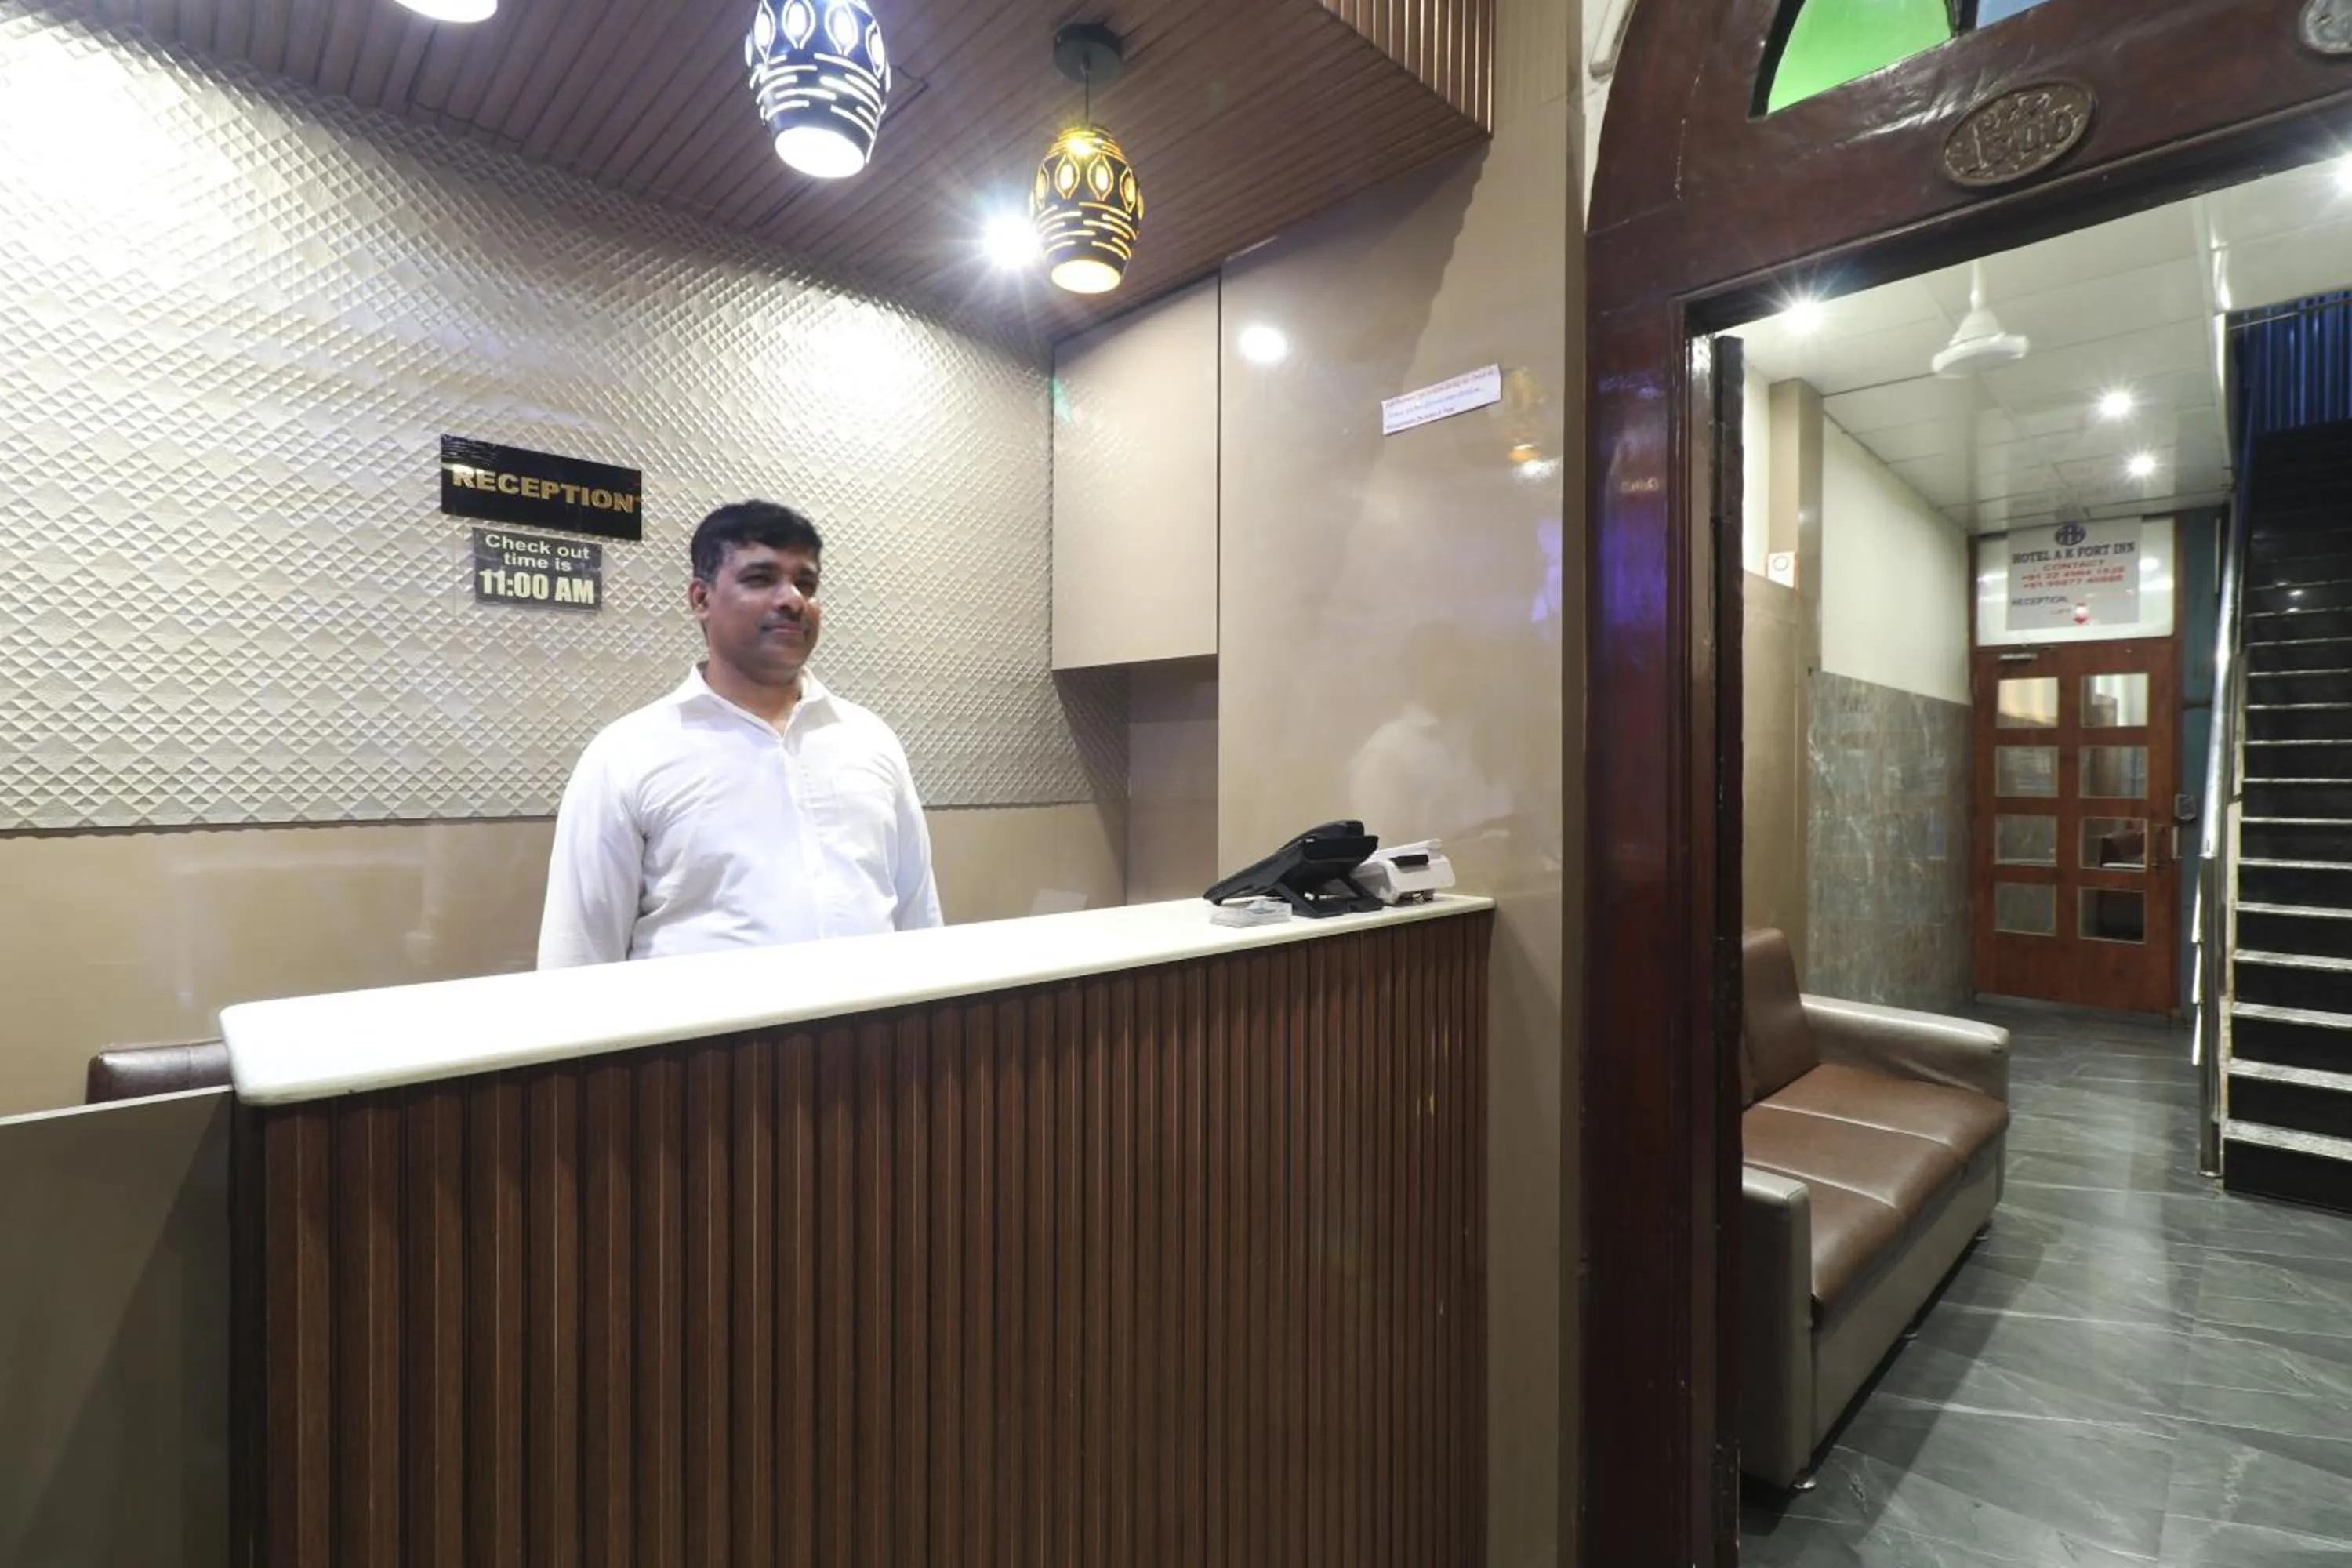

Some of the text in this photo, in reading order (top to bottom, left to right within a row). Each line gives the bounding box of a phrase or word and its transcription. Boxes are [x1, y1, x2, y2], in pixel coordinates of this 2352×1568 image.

[452, 463, 633, 514] RECEPTION
[485, 534, 590, 560] Check out
[2012, 550, 2051, 564] HOTEL
[2054, 550, 2061, 560] A
[2078, 544, 2111, 558] FORT
[2113, 541, 2136, 554] INN
[504, 553, 572, 572] time is
[480, 569, 595, 604] 11:00 AM
[2012, 595, 2070, 607] RECEPTION
